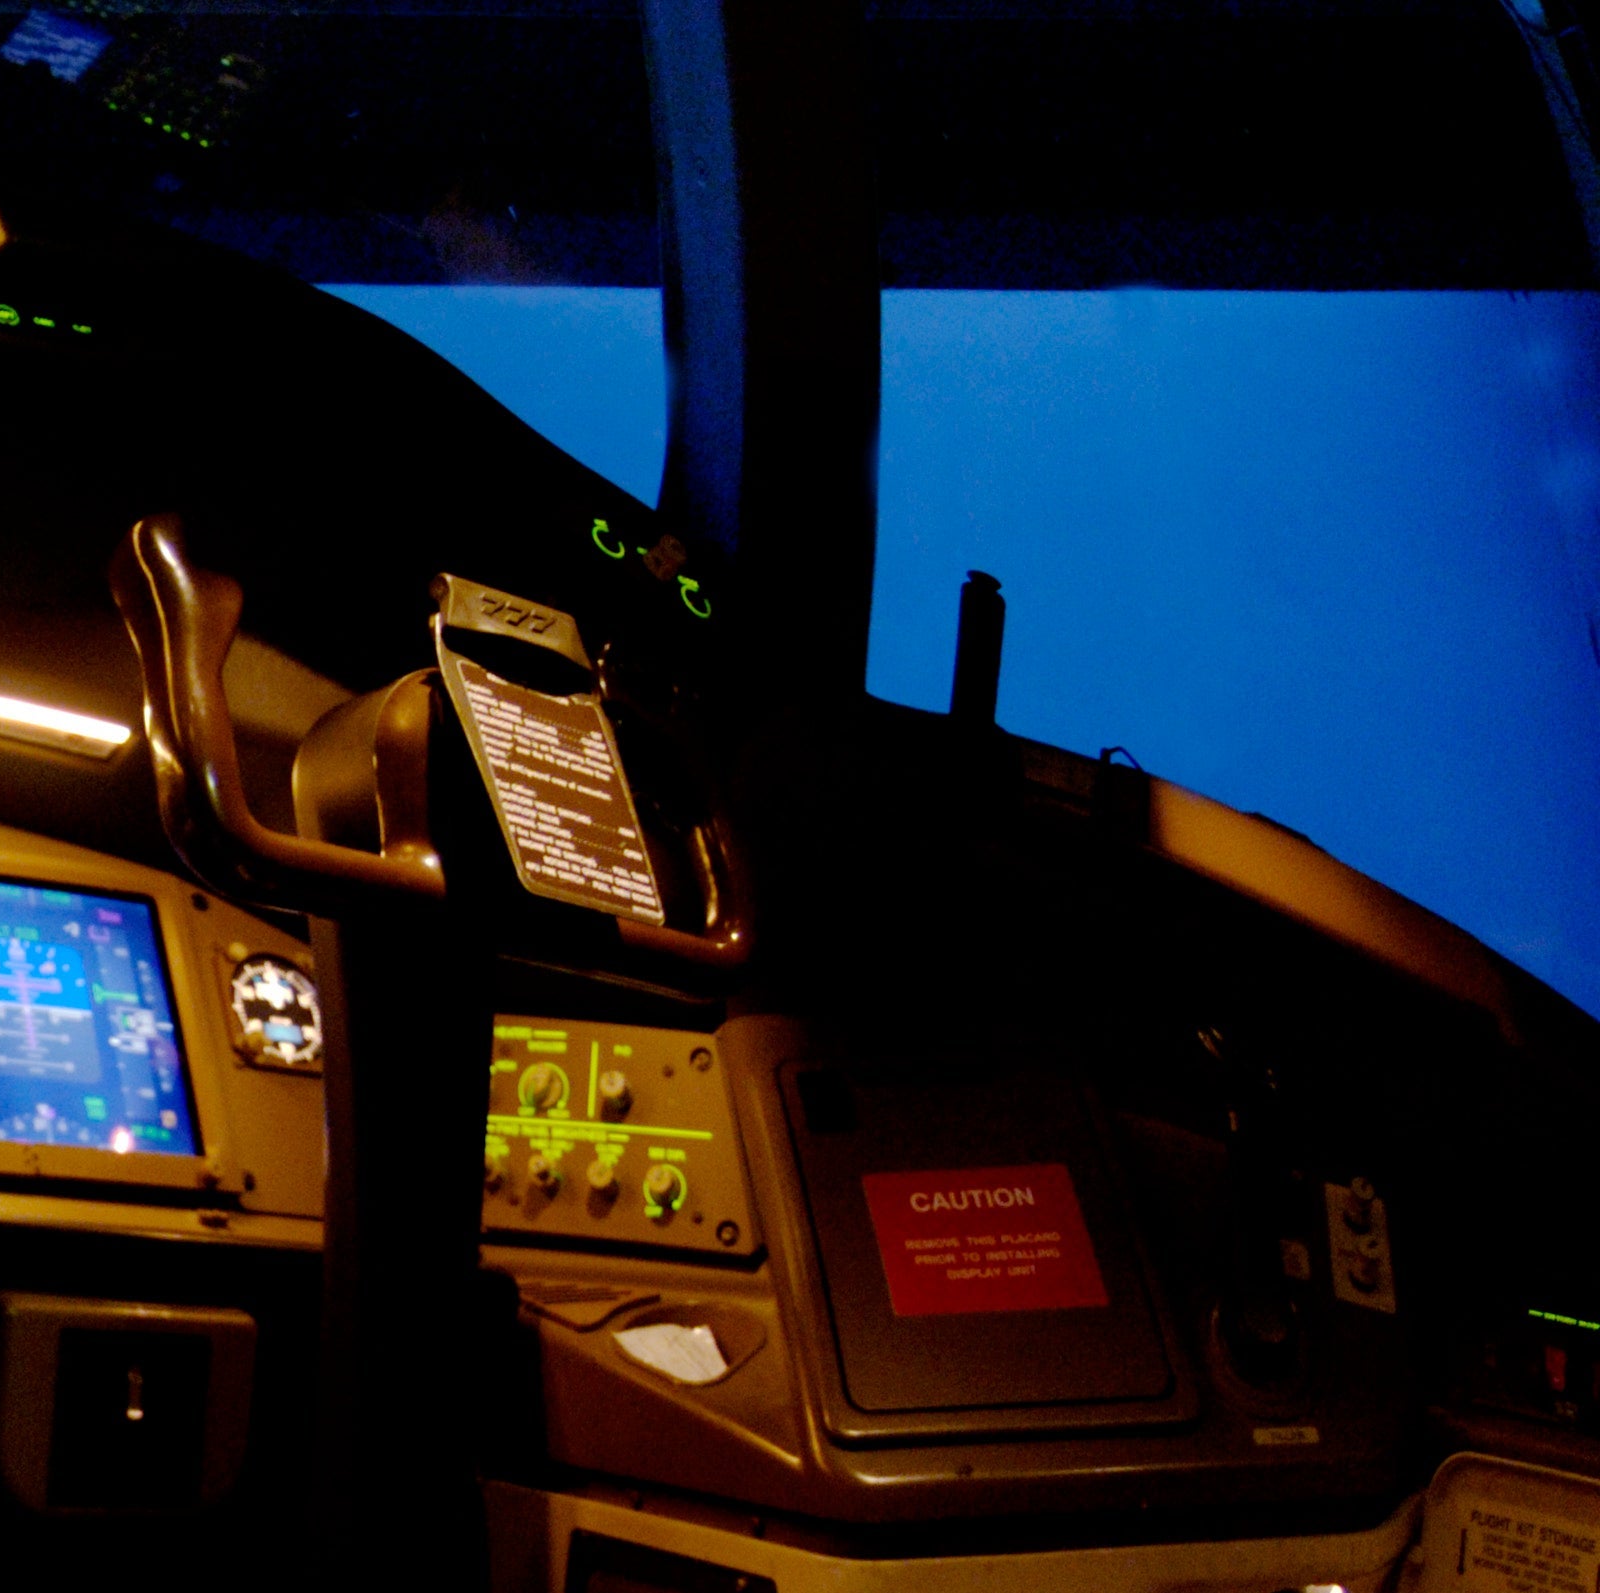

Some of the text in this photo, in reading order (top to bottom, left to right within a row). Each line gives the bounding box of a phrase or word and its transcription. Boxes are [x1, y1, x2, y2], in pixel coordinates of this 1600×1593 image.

[480, 592, 558, 633] 777
[910, 1187, 1035, 1213] CAUTION
[967, 1236, 996, 1246] THIS
[1001, 1232, 1060, 1244] PLACARD
[915, 1255, 955, 1265] PRIOR
[963, 1252, 980, 1262] TO
[947, 1268, 1001, 1280] DISPLAY
